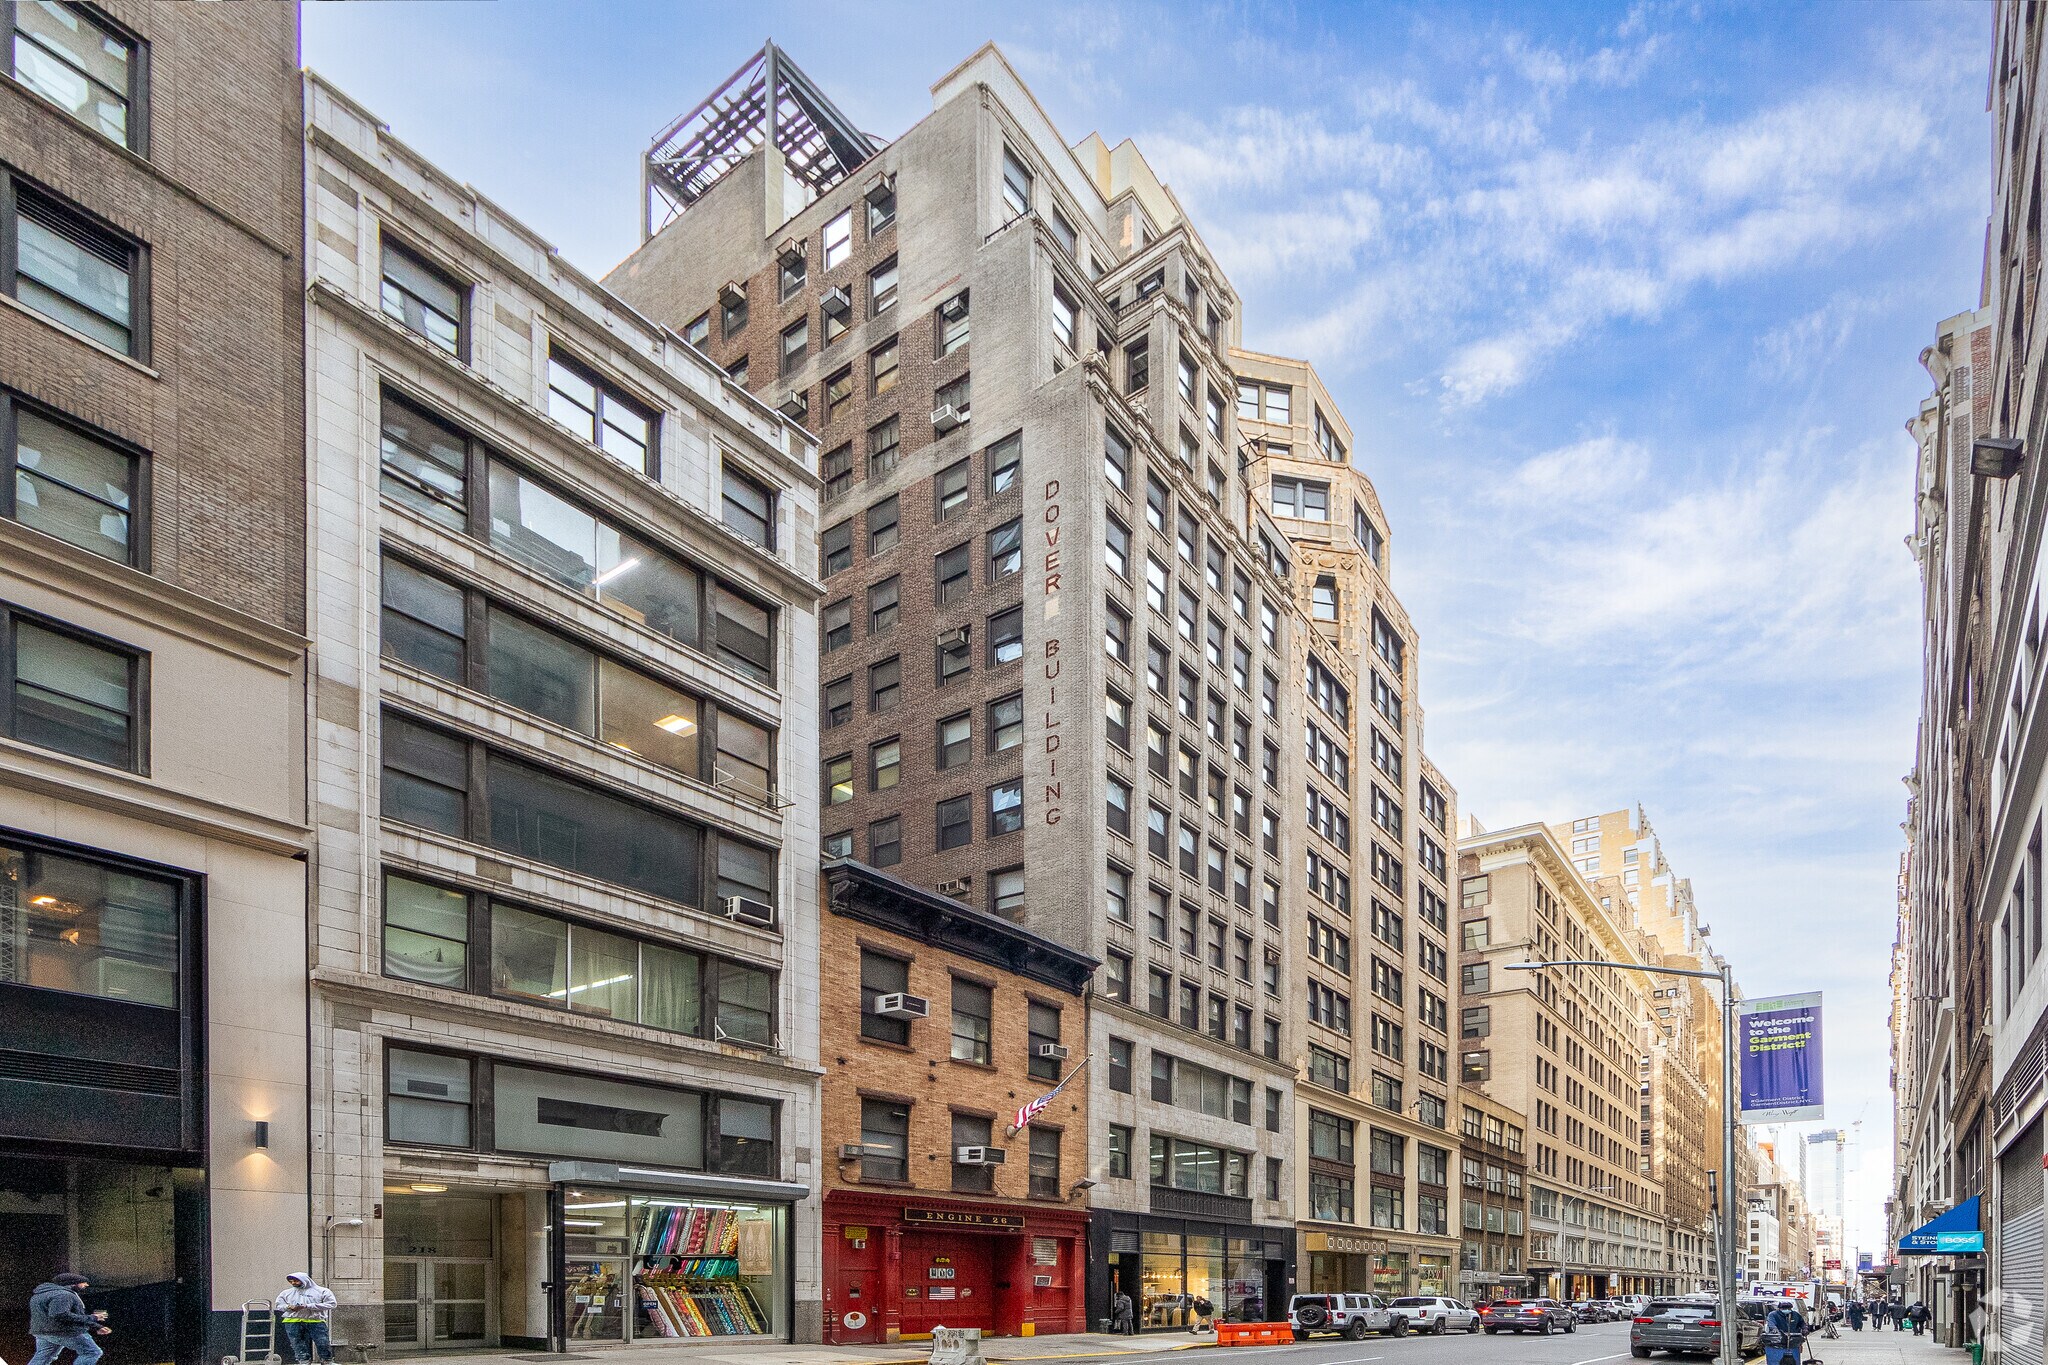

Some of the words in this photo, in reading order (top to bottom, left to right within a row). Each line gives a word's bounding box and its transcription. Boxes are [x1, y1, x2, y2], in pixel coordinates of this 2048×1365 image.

[1045, 479, 1062, 596] DOVER
[1045, 638, 1062, 826] BUILDING
[1748, 1015, 1815, 1028] Welcome
[1748, 1028, 1764, 1036] to
[1767, 1026, 1791, 1035] the
[1749, 1031, 1812, 1044] Garment
[1749, 1040, 1806, 1052] District!
[926, 1212, 982, 1223] ENGINE
[992, 1216, 1007, 1224] 26
[1753, 1286, 1809, 1299] FedEx
